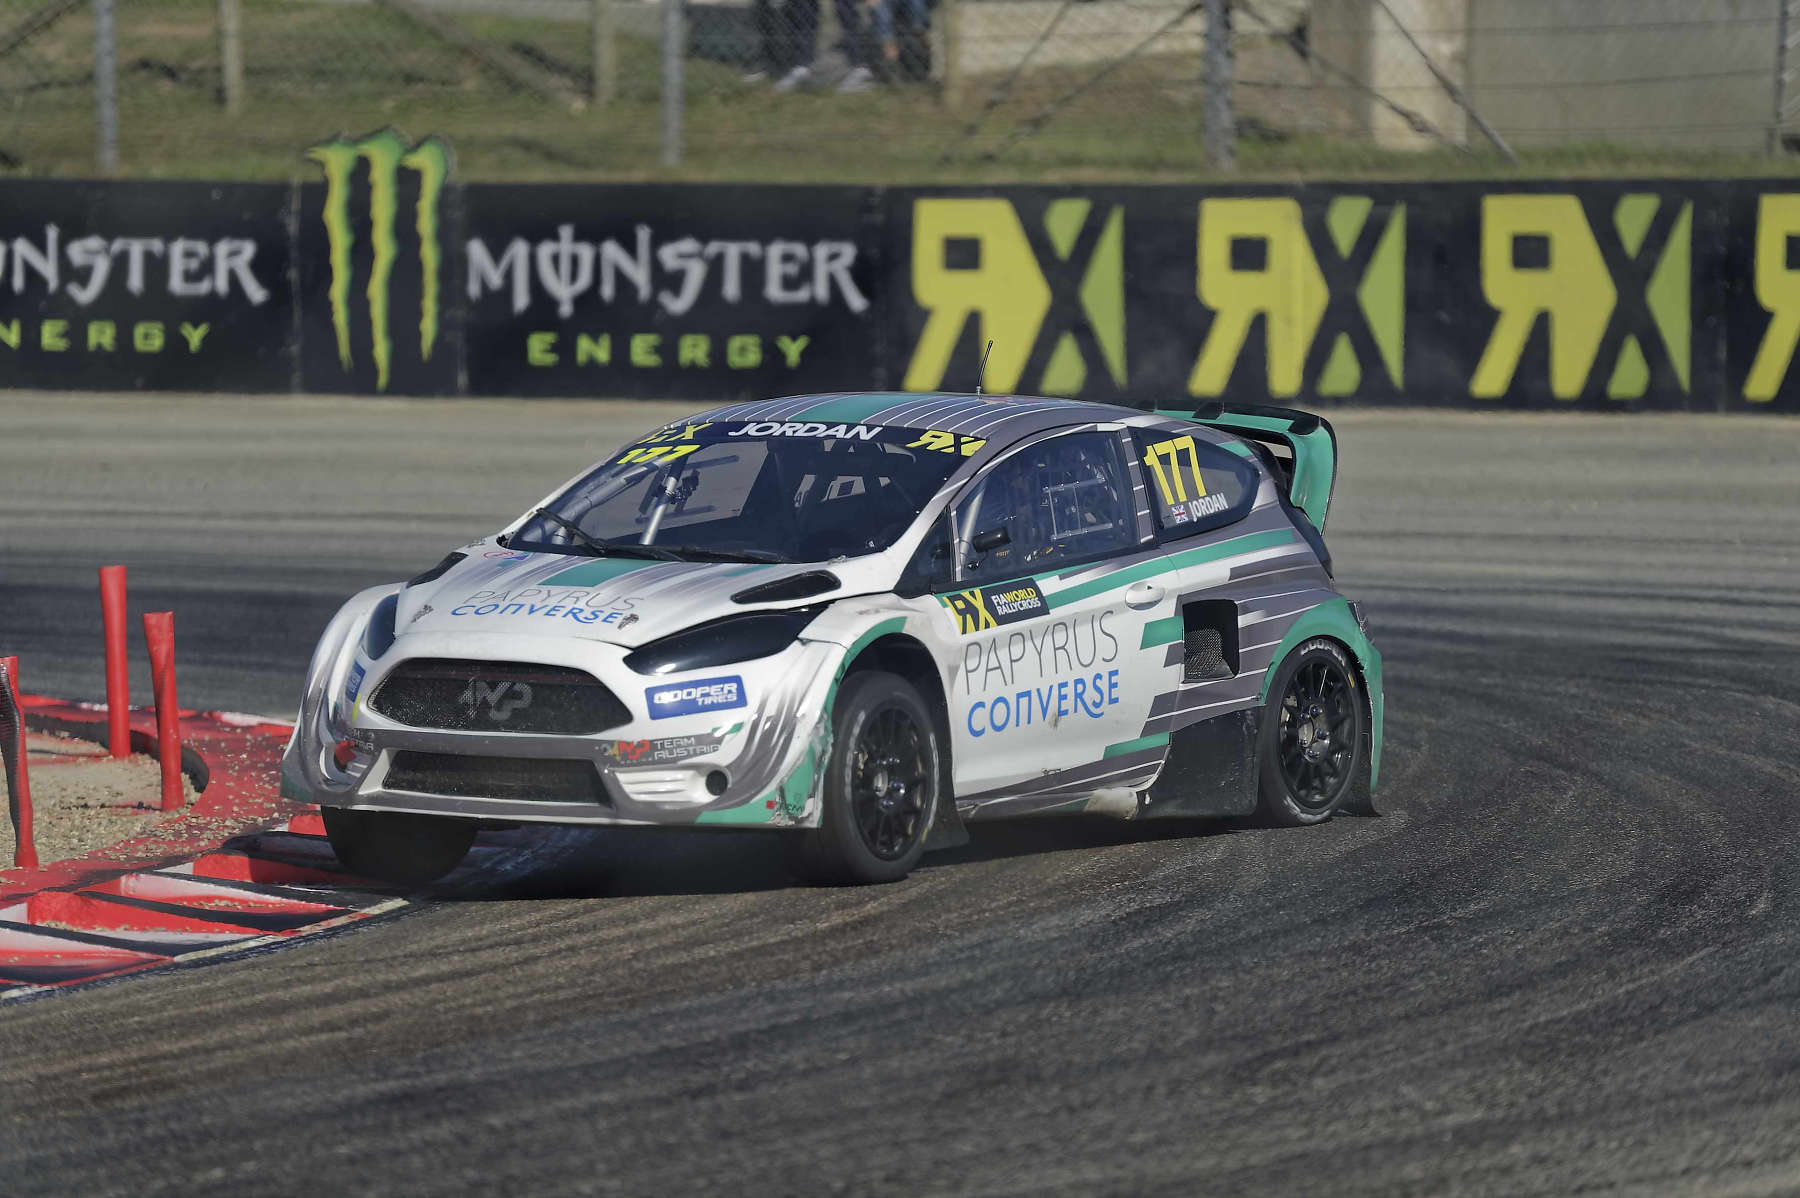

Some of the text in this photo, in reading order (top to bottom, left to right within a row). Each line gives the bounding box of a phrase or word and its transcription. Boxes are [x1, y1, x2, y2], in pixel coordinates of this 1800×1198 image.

[466, 223, 869, 318] MONSTER
[526, 331, 811, 369] ENERGY
[728, 422, 883, 441] JORDAN
[616, 444, 701, 464] 177
[1143, 435, 1207, 505] 177
[1188, 492, 1228, 522] JORDAN
[462, 588, 644, 612] PAPYRUS
[996, 597, 1041, 616] RALLYCROSS
[964, 610, 1118, 695] PAPYRUS
[654, 736, 695, 750] TEAM
